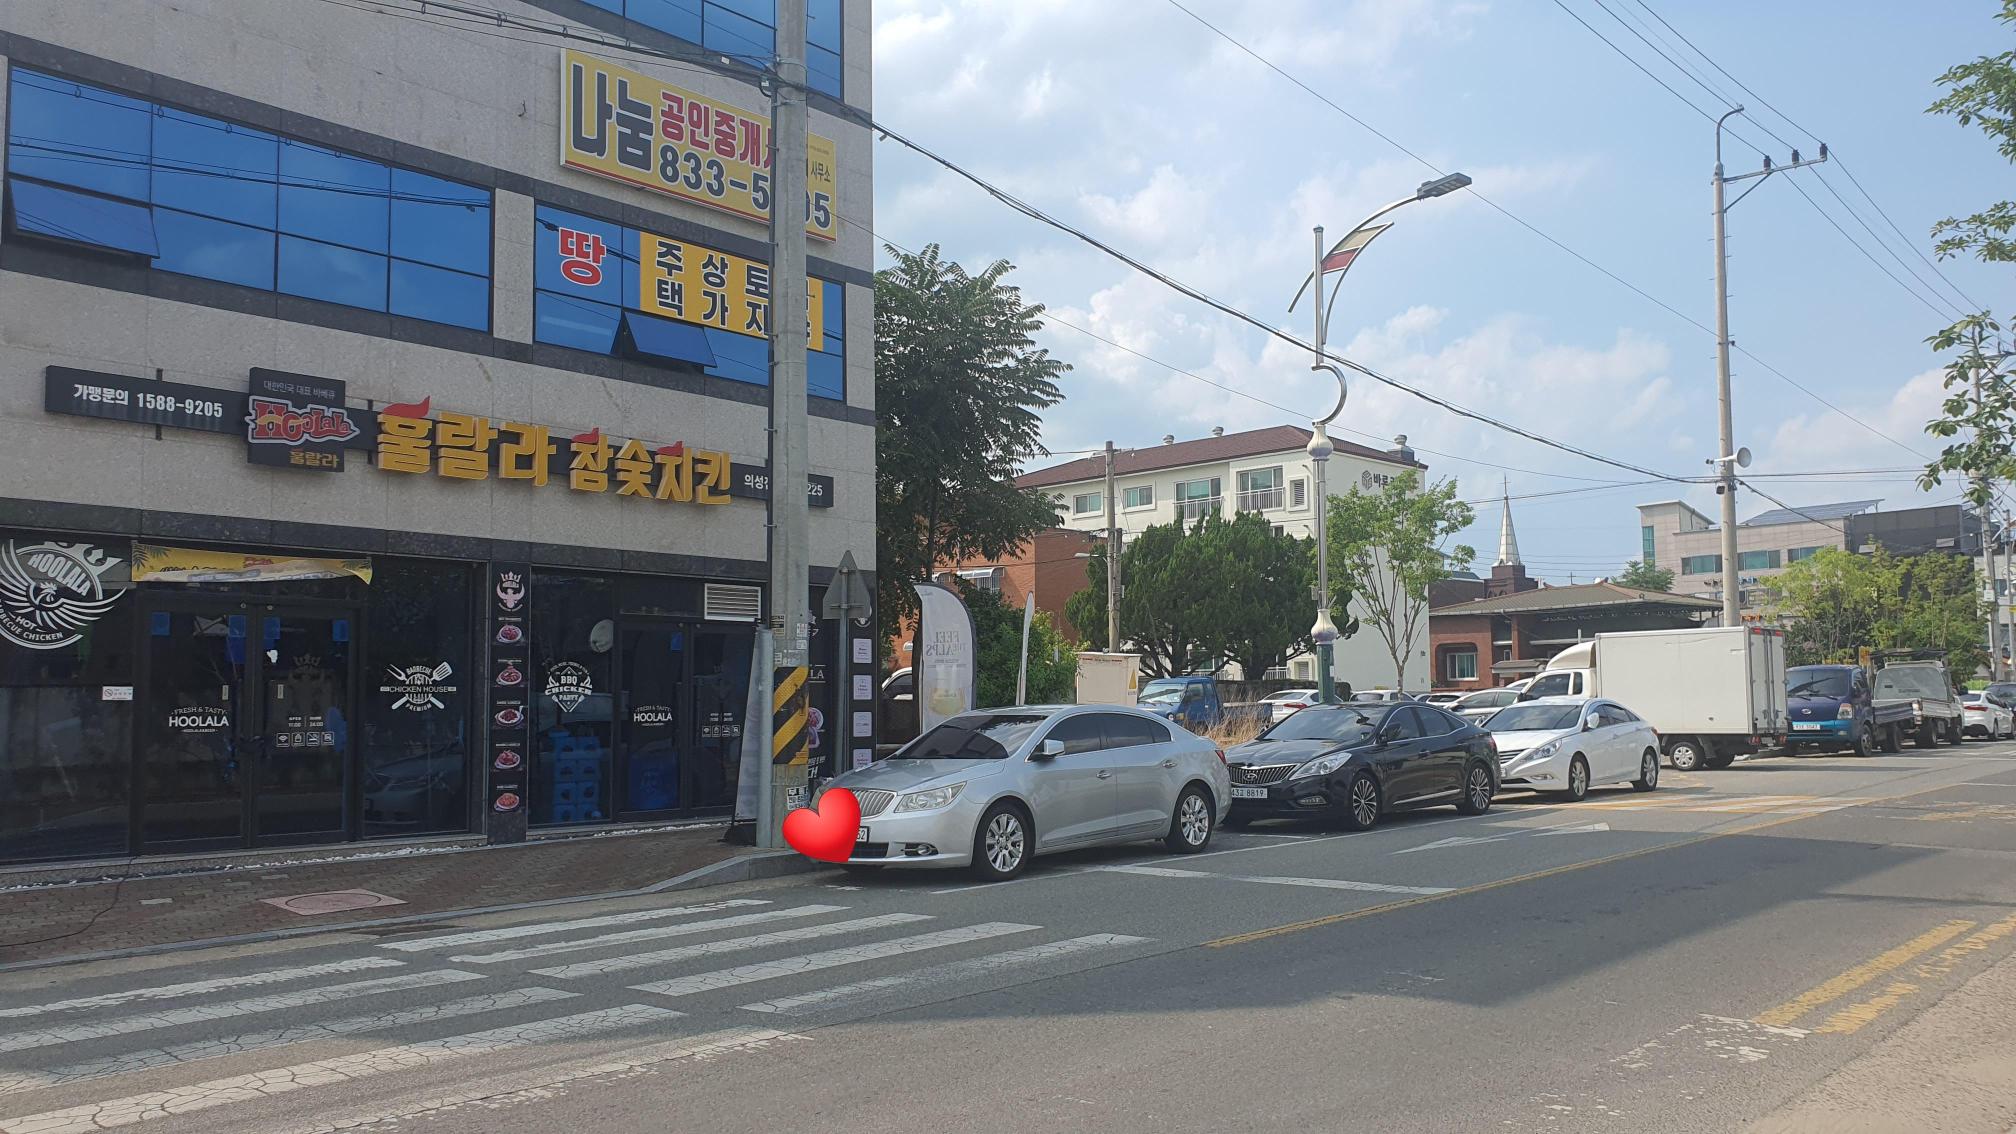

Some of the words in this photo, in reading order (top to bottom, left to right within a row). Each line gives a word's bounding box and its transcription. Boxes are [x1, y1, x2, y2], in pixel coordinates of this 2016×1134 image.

[571, 63, 654, 172] 나눔
[811, 160, 831, 182] 사무소
[558, 227, 606, 286] 땅
[263, 380, 294, 393] 대한민국
[73, 384, 129, 405] 가맹문의
[137, 392, 223, 418] 1588-9205
[377, 396, 556, 487] 훌랄라
[569, 427, 732, 504] 참숯치킨
[27, 553, 91, 597] HOOLALA
[16, 616, 37, 630] HOT
[23, 632, 63, 641] CHICKEN
[405, 665, 433, 676] BARBECUE
[561, 675, 577, 685] BBQ
[545, 685, 592, 695] CHICKEN
[204, 706, 226, 715] TASTY
[405, 703, 432, 711] PREMIUM
[168, 715, 229, 727] HOOLALA
[633, 712, 672, 722] HOOLALA
